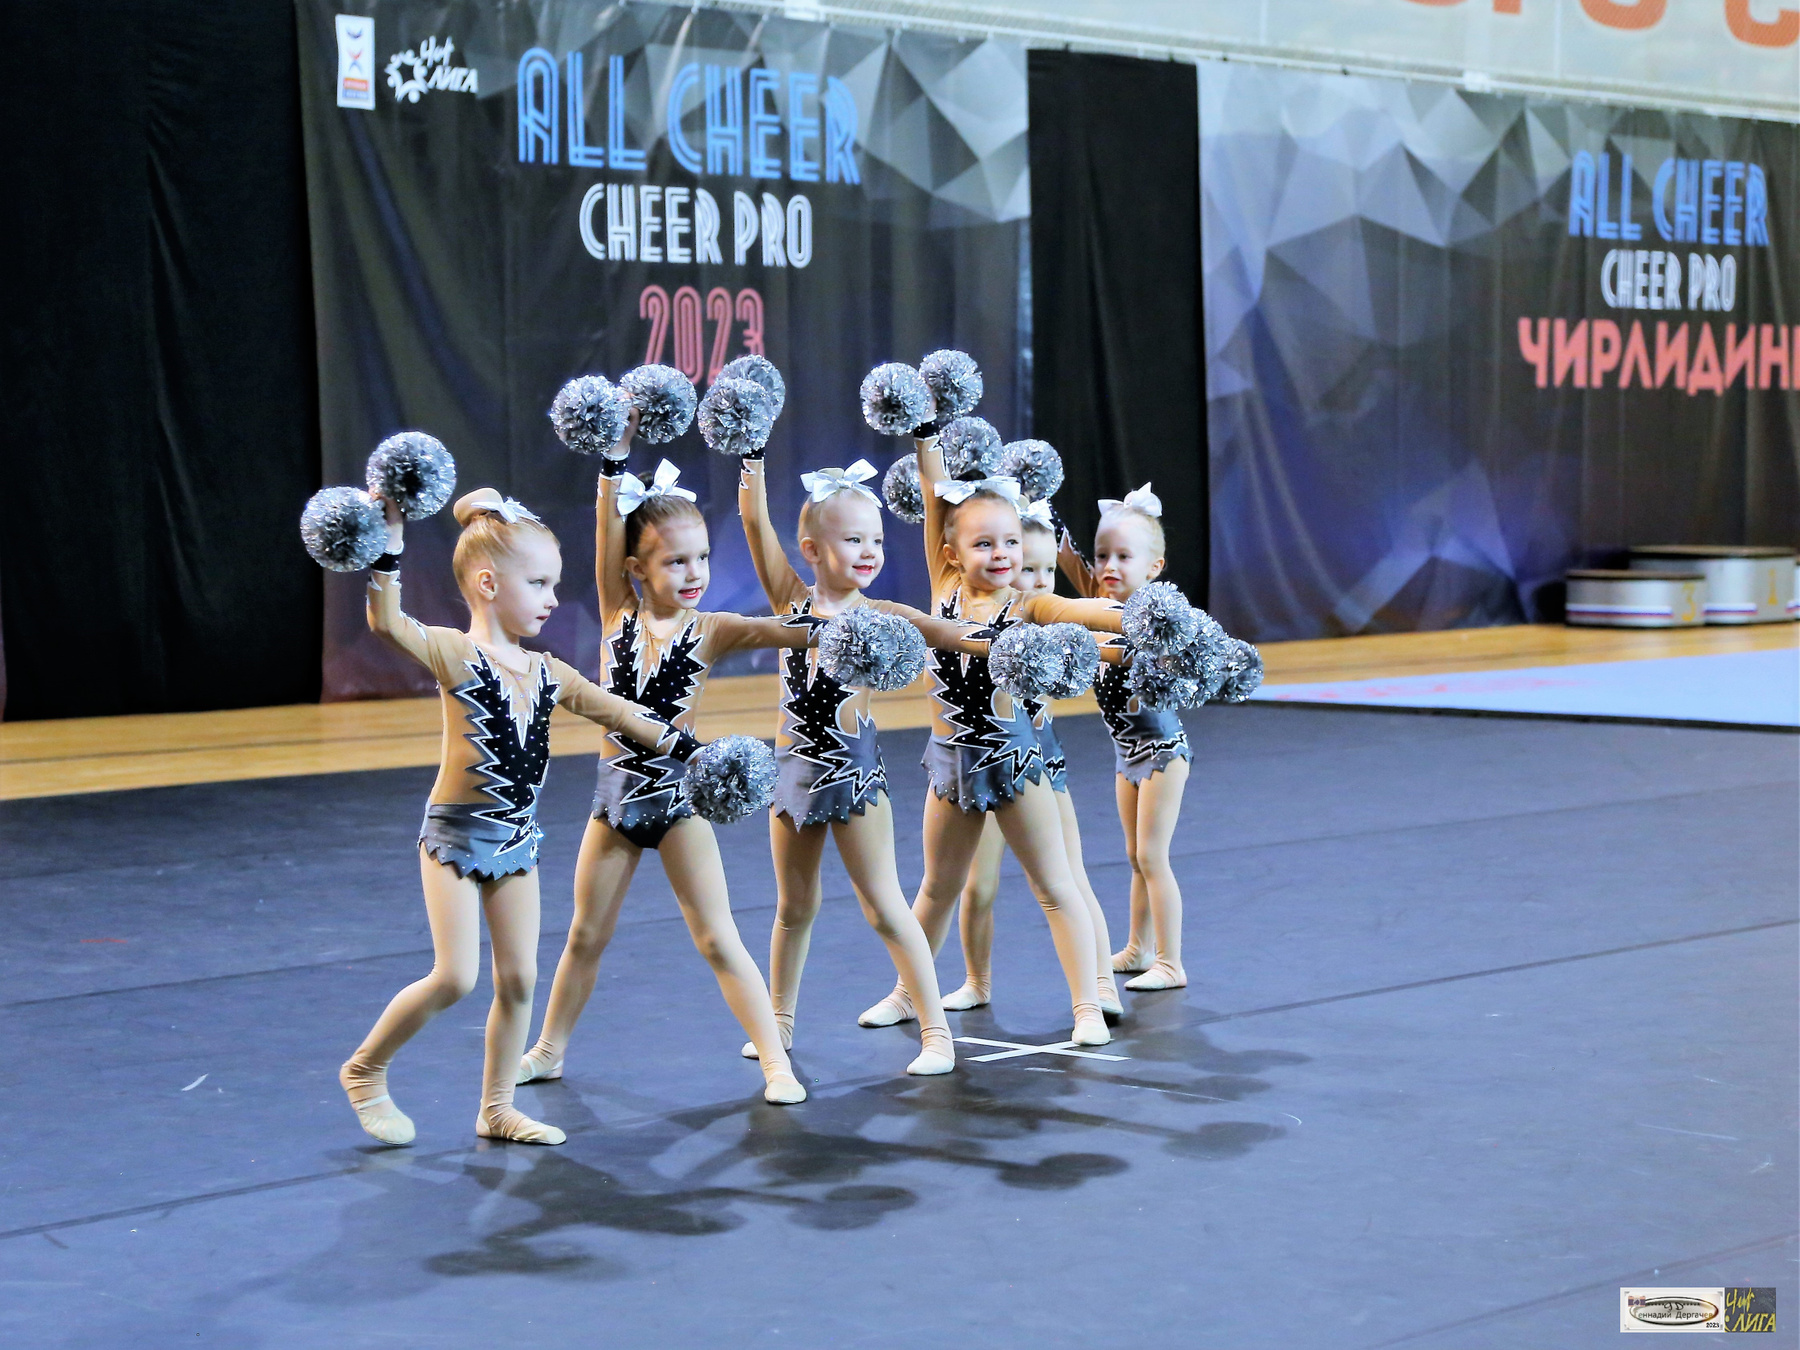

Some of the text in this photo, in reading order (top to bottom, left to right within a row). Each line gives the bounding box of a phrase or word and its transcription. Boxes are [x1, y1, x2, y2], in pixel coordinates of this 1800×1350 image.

[517, 47, 861, 185] ALL CHEER
[579, 183, 813, 269] CHEER PRO
[1568, 150, 1770, 247] ALL CHEER
[1600, 249, 1737, 312] CHEER PRO
[639, 284, 766, 387] 2023
[1517, 316, 1800, 397] ЧИРЛИДИН
